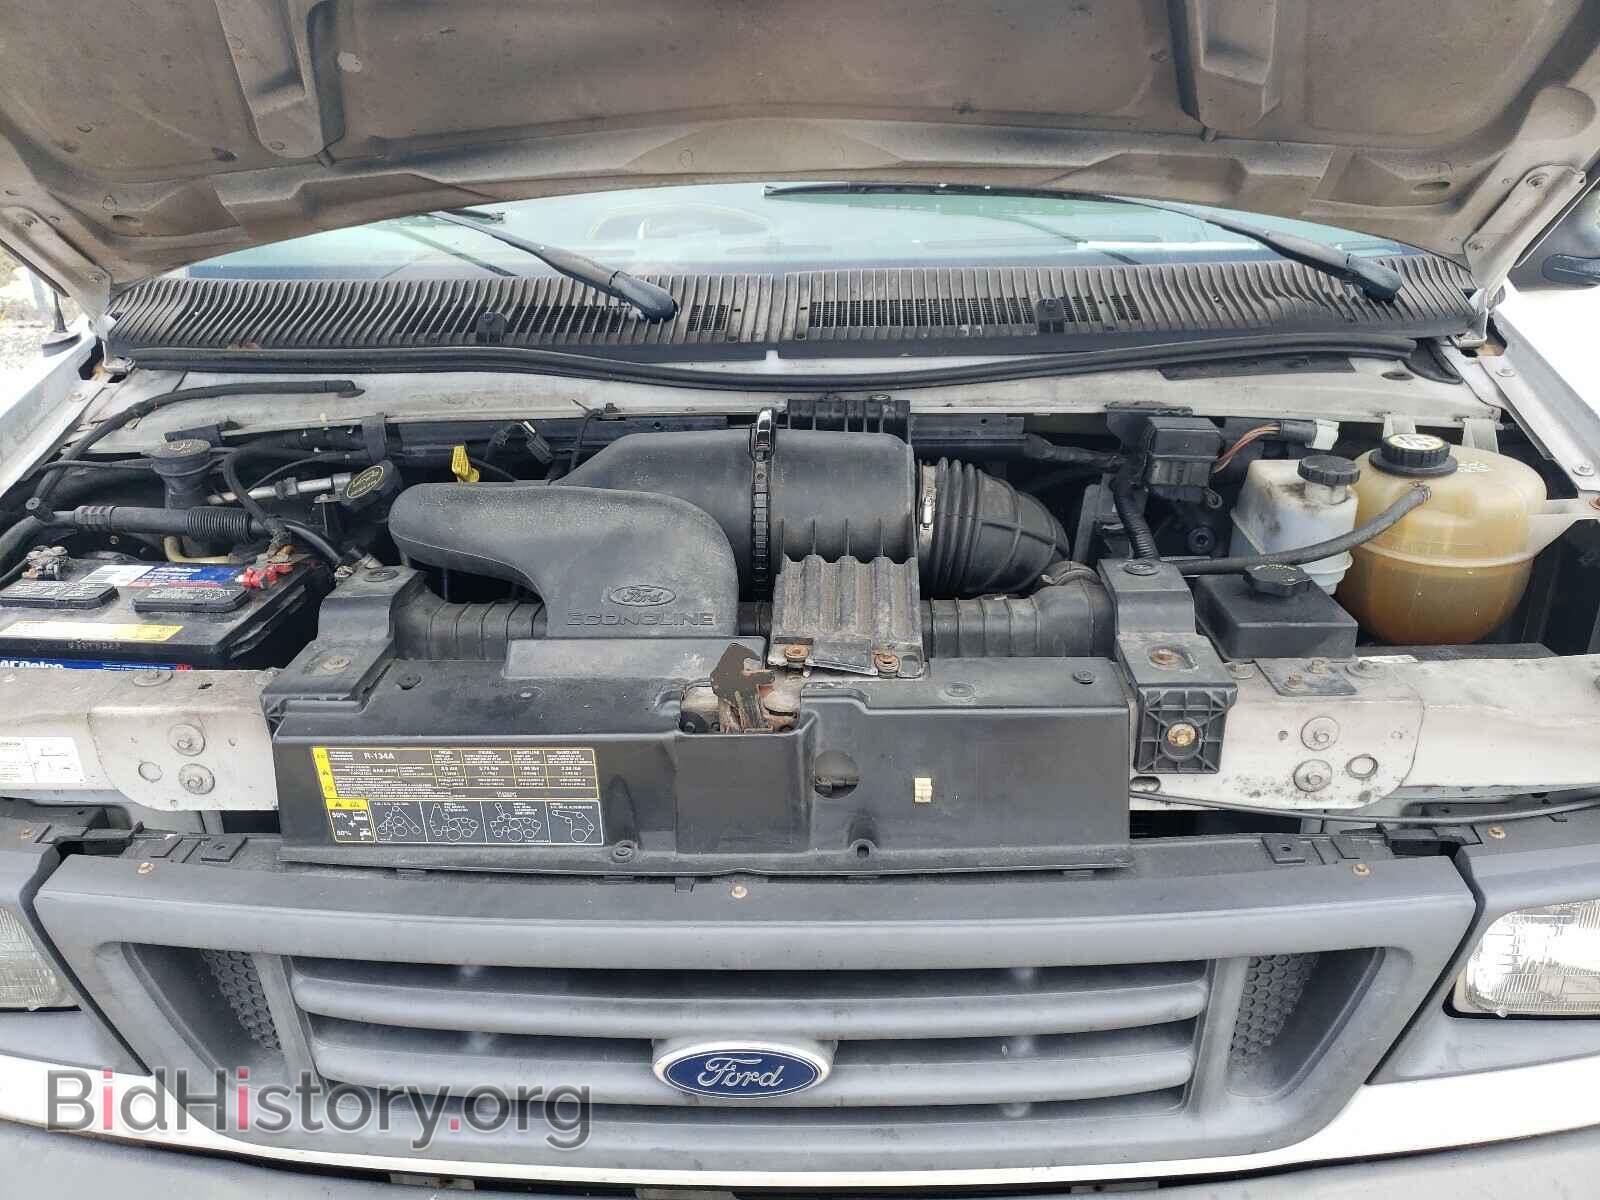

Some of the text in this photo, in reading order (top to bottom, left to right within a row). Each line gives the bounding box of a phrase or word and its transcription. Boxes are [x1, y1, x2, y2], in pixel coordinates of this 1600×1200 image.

[623, 588, 664, 603] Ford
[567, 611, 715, 626] ECONOLINE
[697, 1057, 785, 1087] Ford
